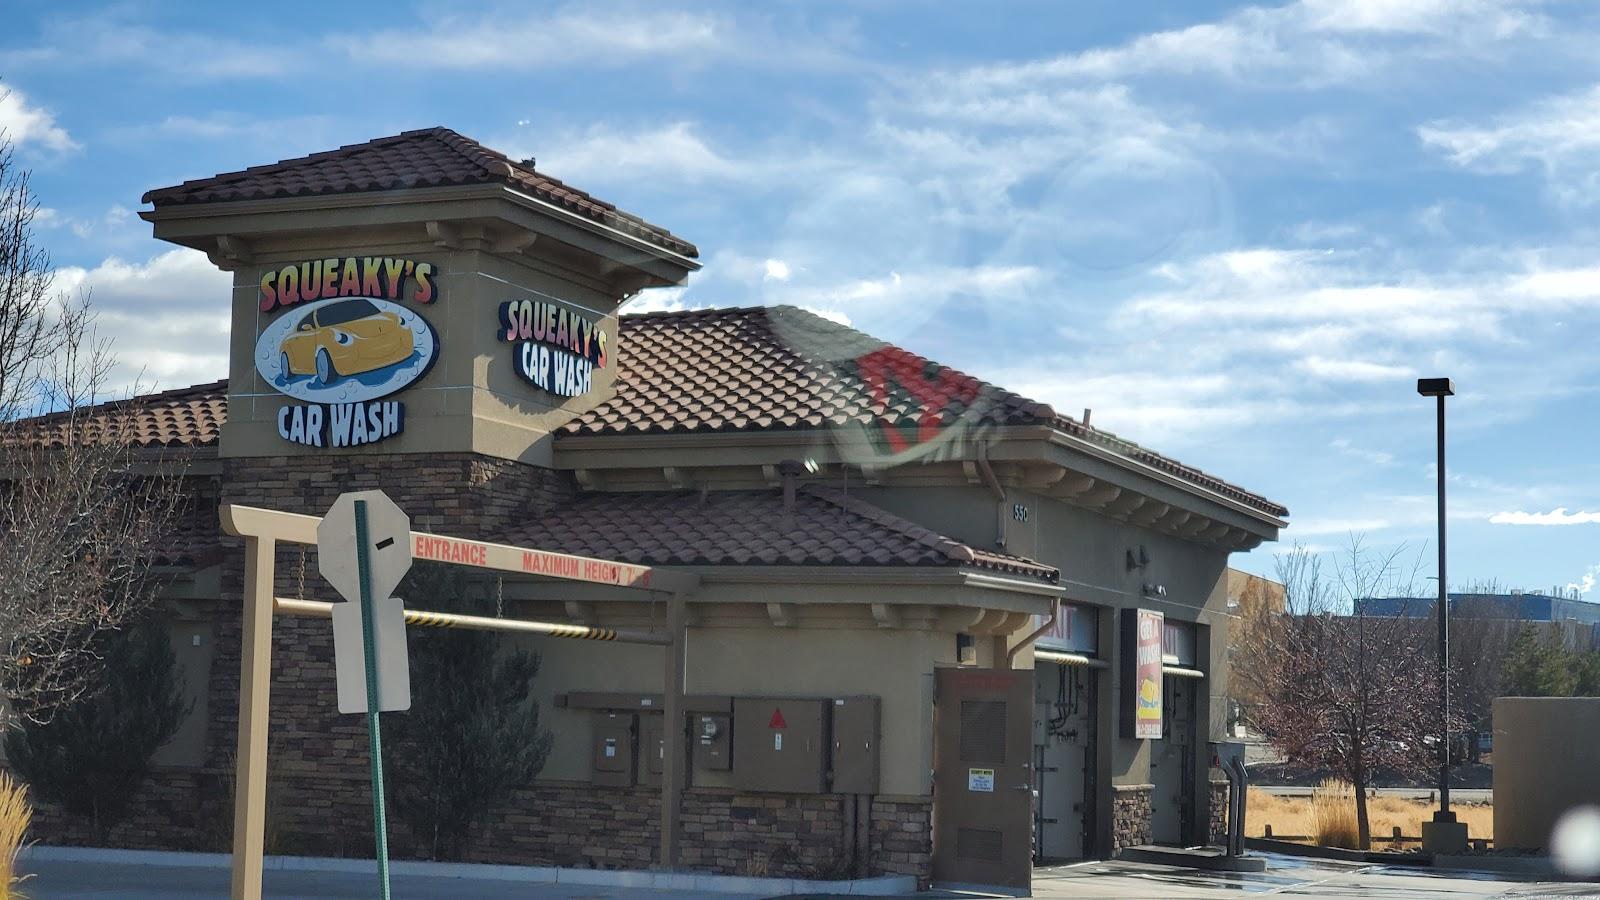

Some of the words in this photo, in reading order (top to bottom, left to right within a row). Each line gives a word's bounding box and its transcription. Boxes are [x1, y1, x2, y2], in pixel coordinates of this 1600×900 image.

[260, 256, 435, 312] SQUEAKY'S
[505, 300, 608, 369] SQUEAKY'S
[522, 342, 550, 391] CAR
[553, 350, 593, 397] WASH
[277, 403, 324, 447] CAR
[329, 401, 402, 448] WASH
[1013, 504, 1028, 522] 550
[415, 536, 487, 566] ENTRANCE
[522, 551, 580, 578] MAXIMUM
